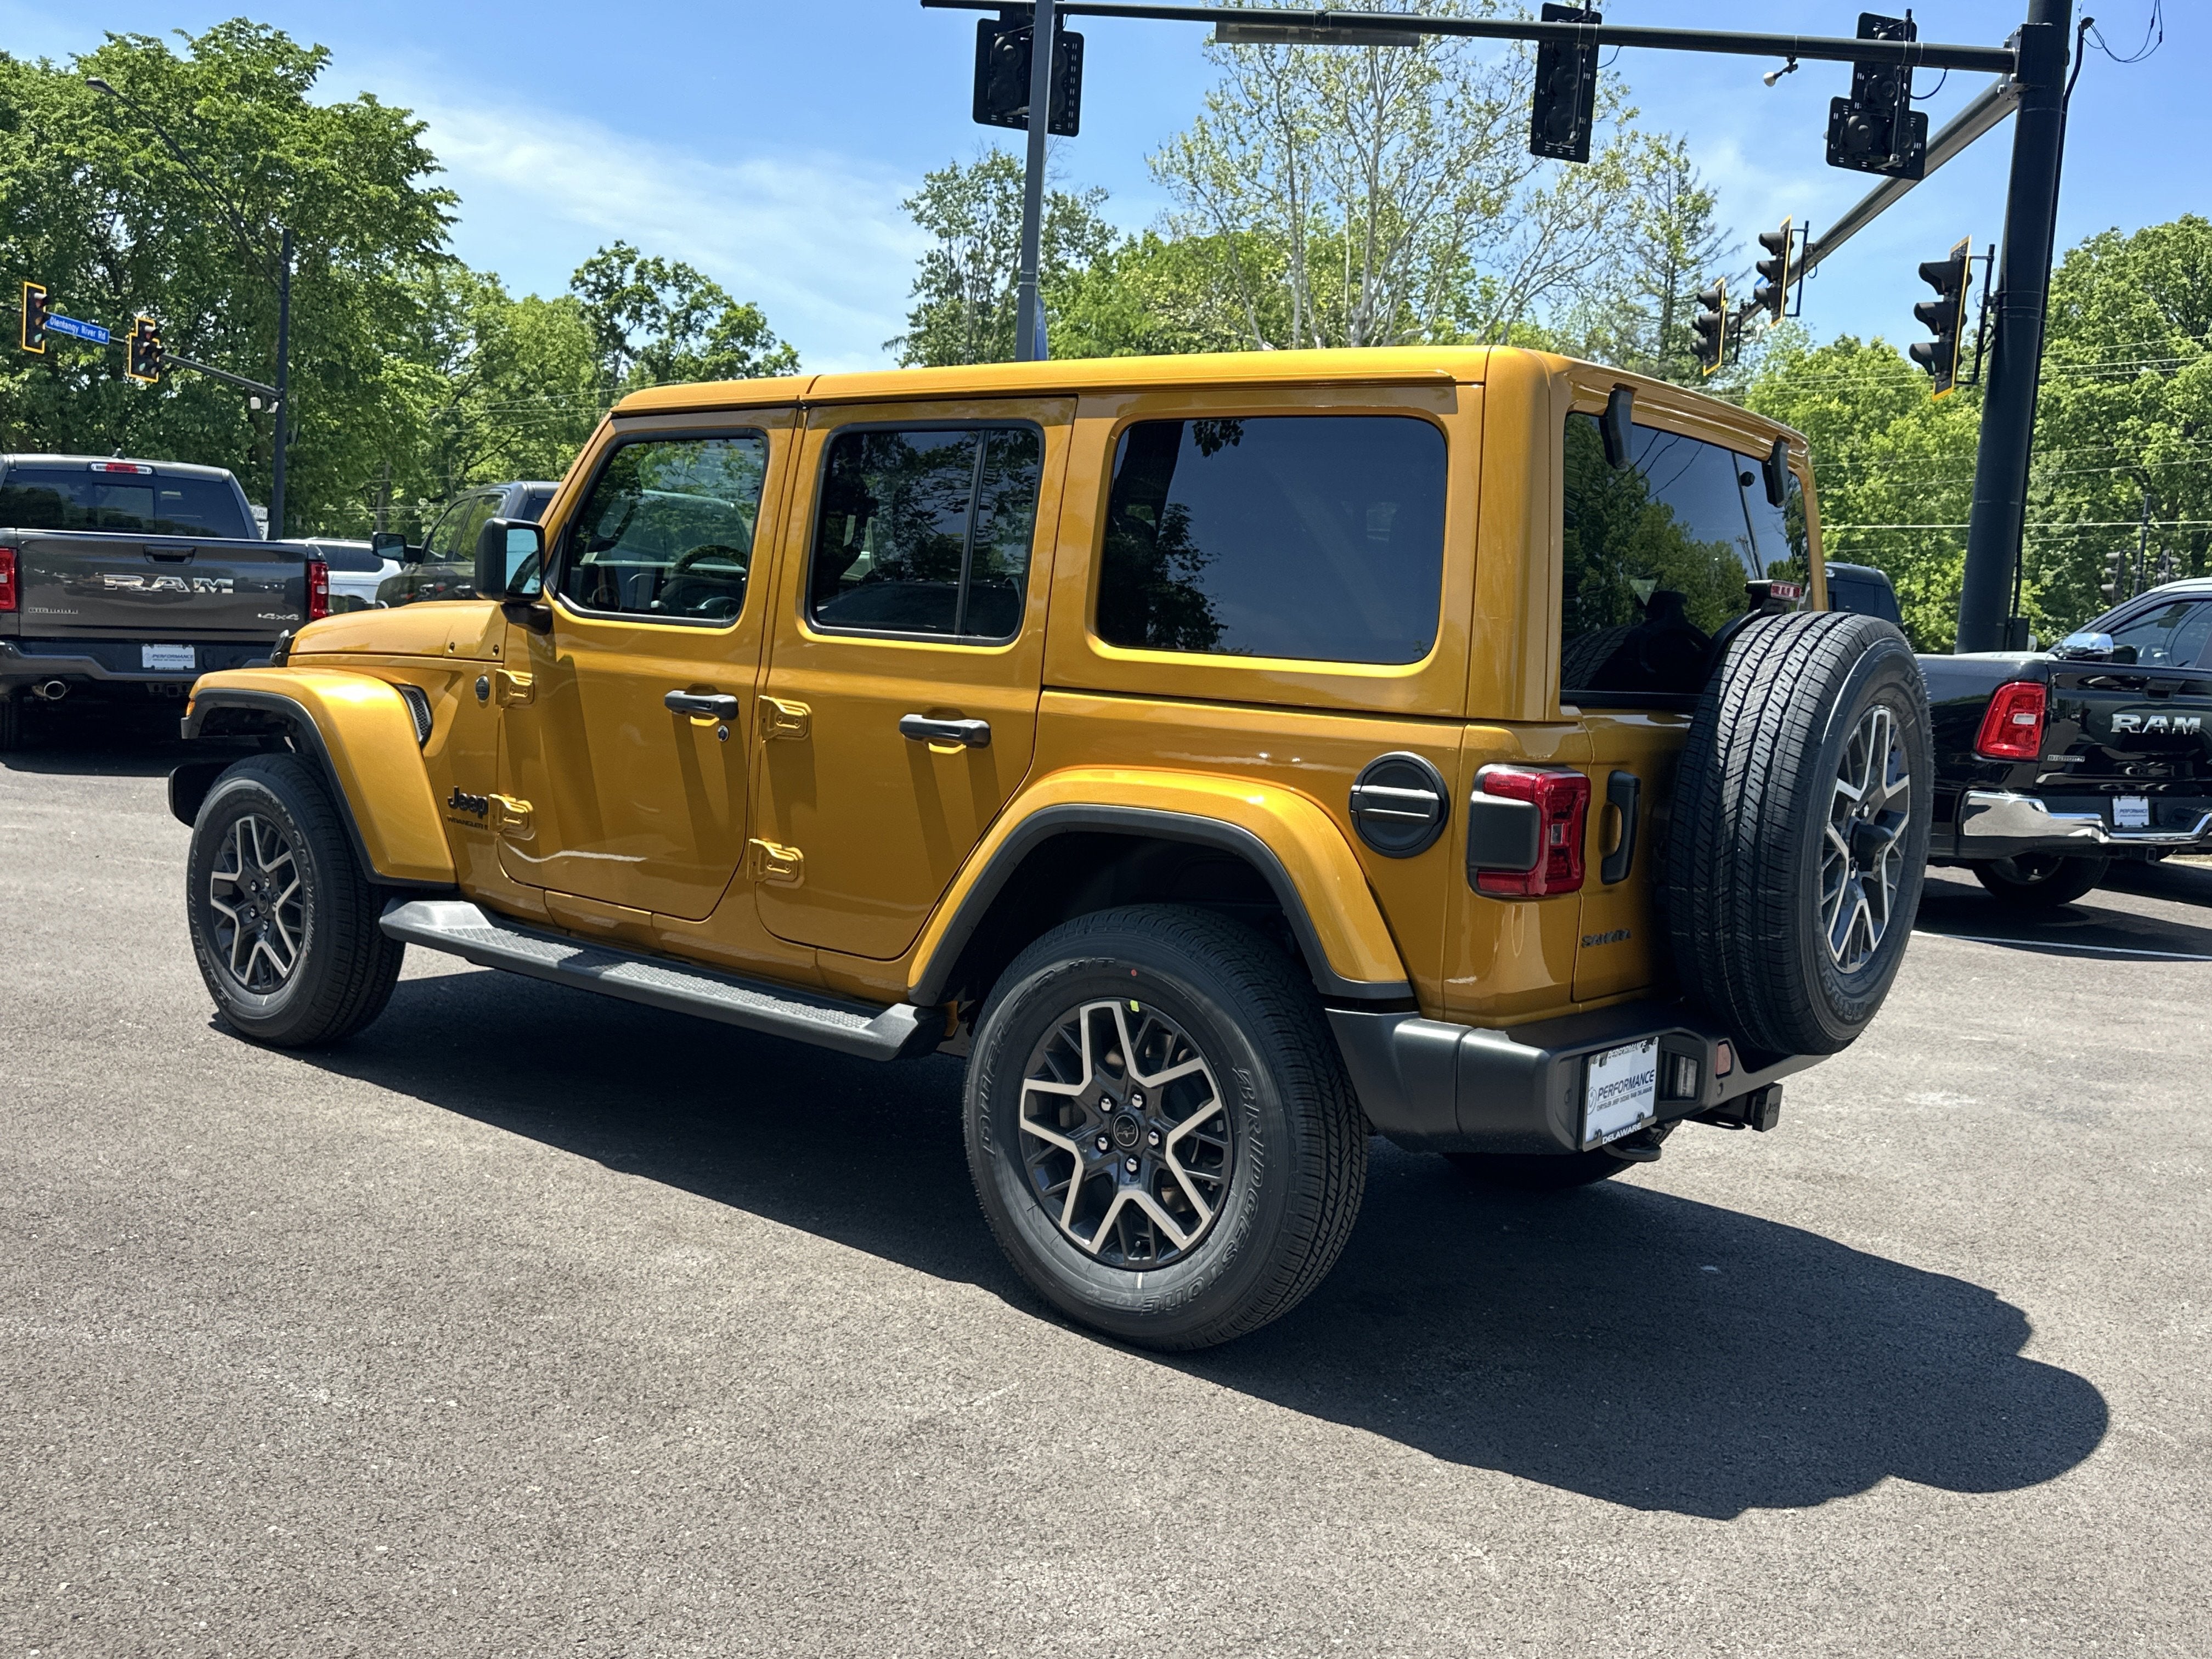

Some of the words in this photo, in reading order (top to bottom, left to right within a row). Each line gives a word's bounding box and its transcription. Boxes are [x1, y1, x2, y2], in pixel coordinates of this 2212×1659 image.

[50, 316, 79, 335] Olentangy
[81, 325, 96, 337] River
[98, 330, 106, 340] Rd
[103, 574, 234, 594] RAM
[2111, 713, 2201, 735] RAM
[447, 786, 488, 820] Jeep
[1581, 928, 1632, 949] SAHARA
[1597, 1069, 1655, 1102] PERFORMANCE
[1602, 1122, 1642, 1145] DELAWARE
[1140, 1067, 1265, 1316] BRIDGESTONE
